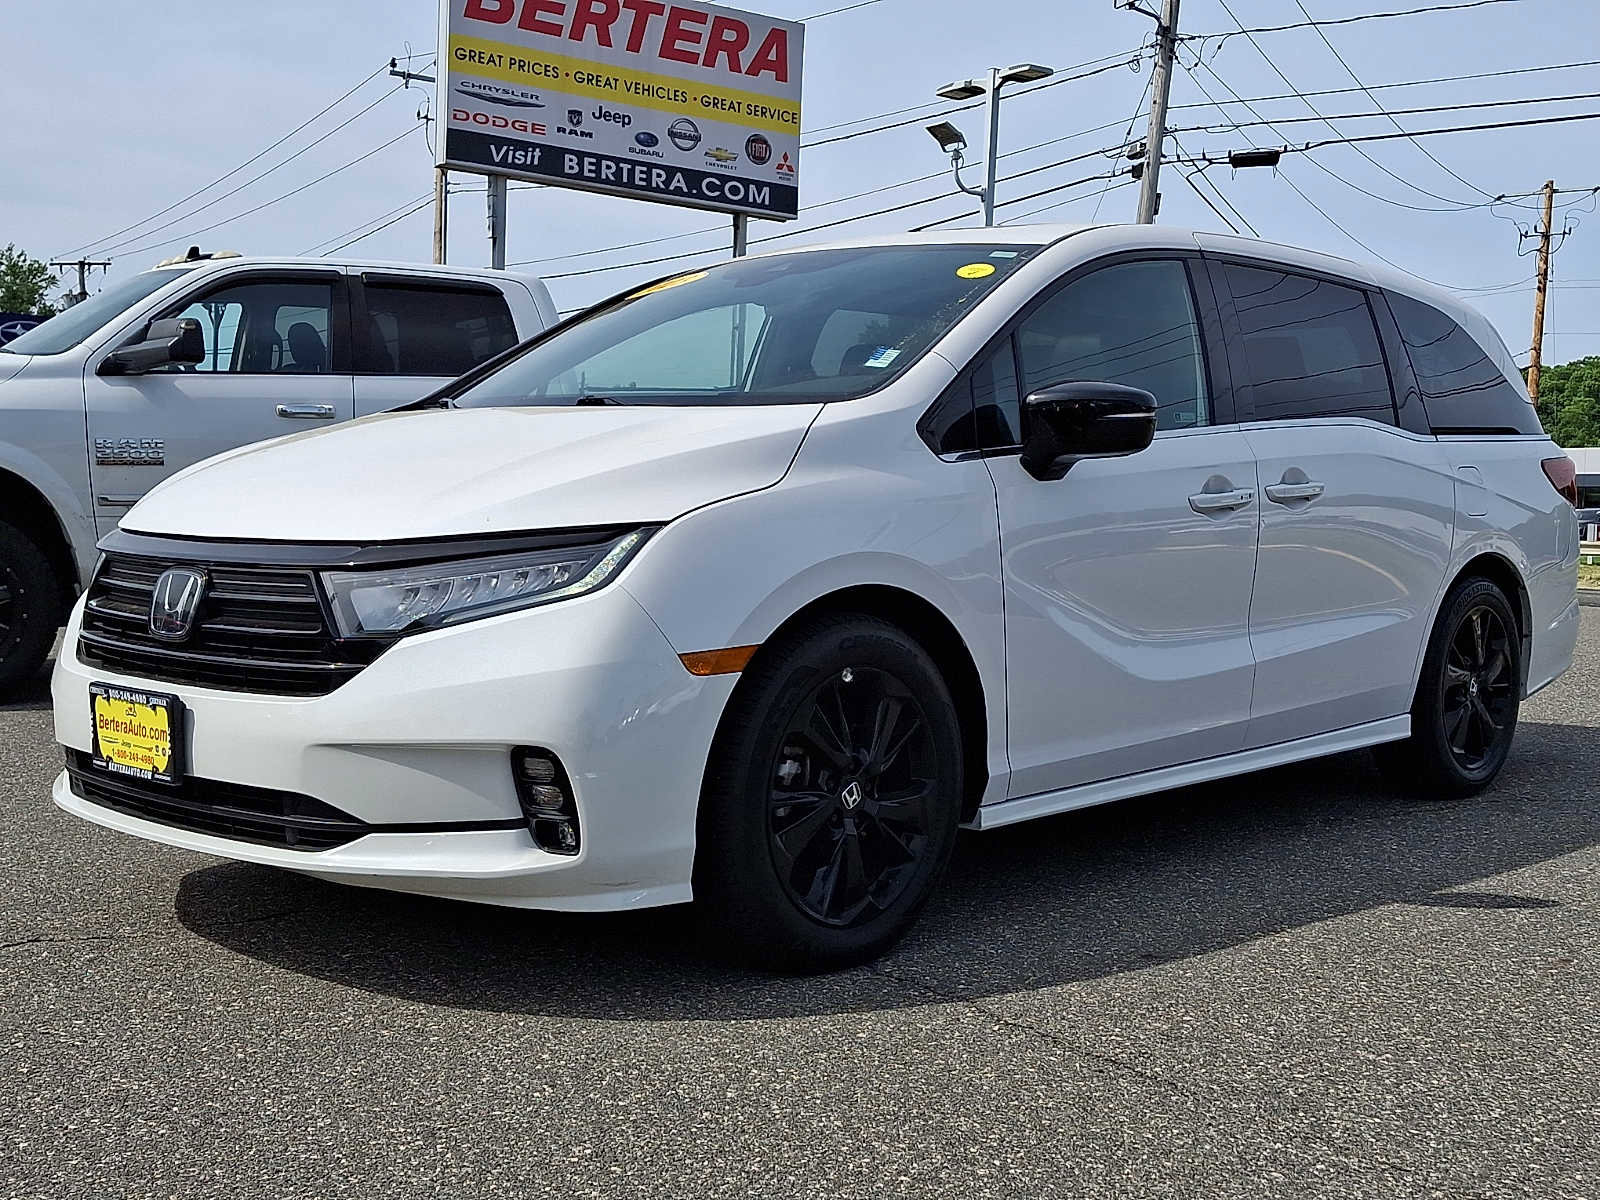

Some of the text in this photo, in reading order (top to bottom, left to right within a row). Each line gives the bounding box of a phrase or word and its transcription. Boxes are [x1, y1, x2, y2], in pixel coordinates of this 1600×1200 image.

[454, 47, 798, 125] GREAT PRICES GREAT VEHICLES GREAT SERVICE
[460, 80, 541, 101] CHRYSLER
[452, 108, 547, 136] DODGE
[592, 105, 632, 128] Jeep
[556, 126, 594, 139] RAM
[671, 130, 699, 141] NISSAN
[628, 146, 664, 158] SUBARU
[751, 142, 767, 157] FIAT
[489, 144, 770, 206] Visit BERTERA.COM
[705, 161, 737, 171] CHEVROLET
[95, 438, 164, 448] RAM
[99, 714, 168, 742] BerteraAuto.com
